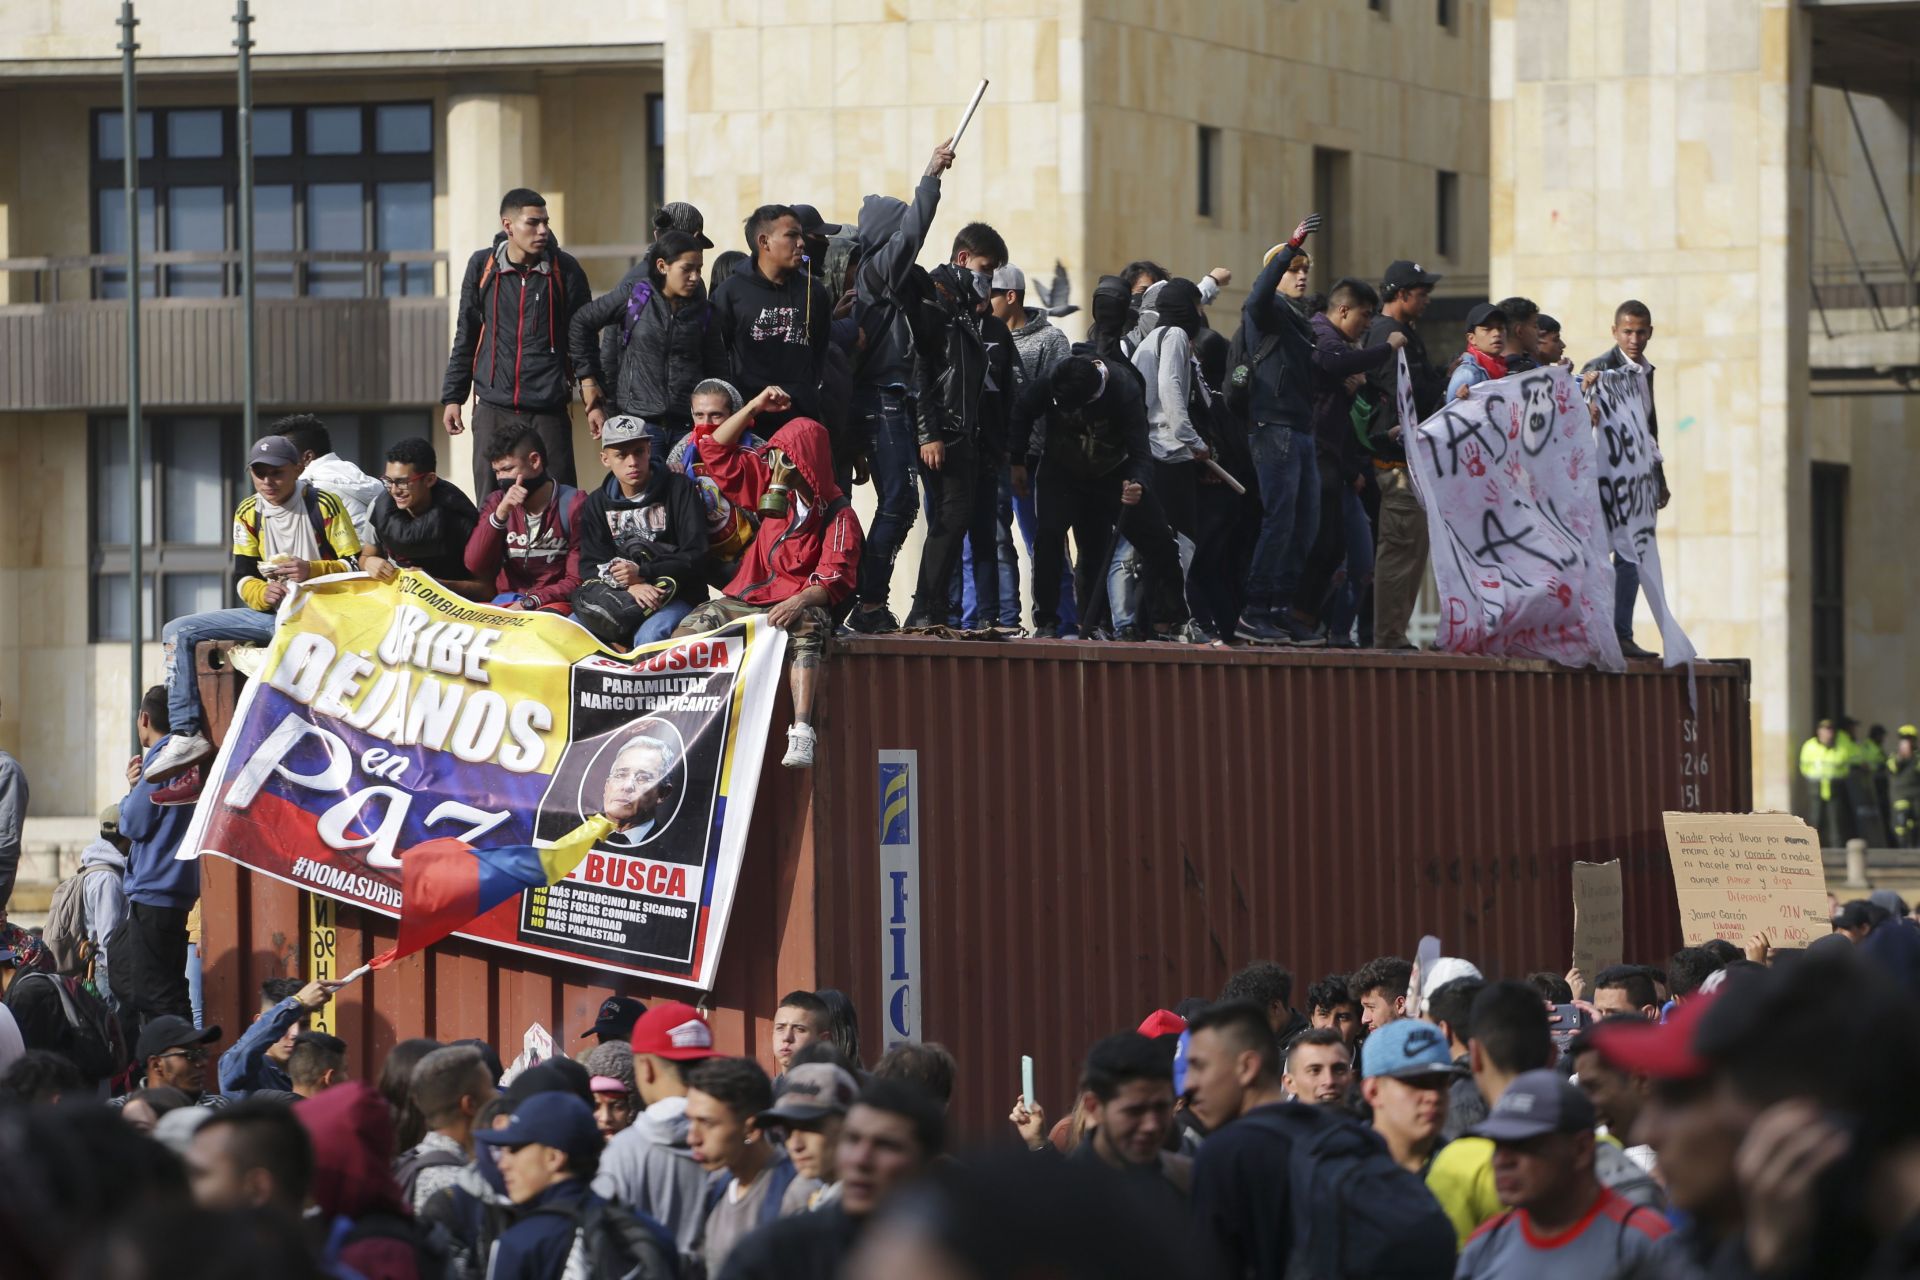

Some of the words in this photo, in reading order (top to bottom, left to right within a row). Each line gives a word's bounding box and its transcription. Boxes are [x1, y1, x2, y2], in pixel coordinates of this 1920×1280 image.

[378, 605, 502, 683] URIBE
[602, 677, 708, 694] PARAMILITAR
[580, 691, 721, 712] NARCOTRAFICANTE
[361, 747, 411, 782] en
[224, 712, 512, 868] Paz
[1713, 847, 1725, 857] de
[1767, 836, 1779, 845] por
[585, 853, 686, 898] BUSCA
[1735, 862, 1753, 870] mal
[1756, 863, 1767, 871] en
[291, 856, 403, 908] #NOMASURIB
[1690, 876, 1719, 887] aunque
[1760, 878, 1767, 890] y
[533, 894, 547, 906] NO
[548, 896, 569, 910] MÁS
[570, 901, 600, 916] FOSAS
[601, 905, 647, 924] COMUNES
[535, 887, 548, 895] NO
[549, 886, 571, 899] MÁS
[572, 891, 628, 908] PATROCINIO
[629, 899, 641, 911] DE
[642, 902, 688, 919] SICARIOS
[531, 916, 544, 928] NO
[545, 918, 566, 932] MÁS
[567, 924, 627, 944] PARAESTADO
[532, 905, 545, 917] NO
[546, 907, 567, 921] MÁS
[568, 913, 622, 931] IMPUNIDAD
[1784, 926, 1809, 940] AÑOS
